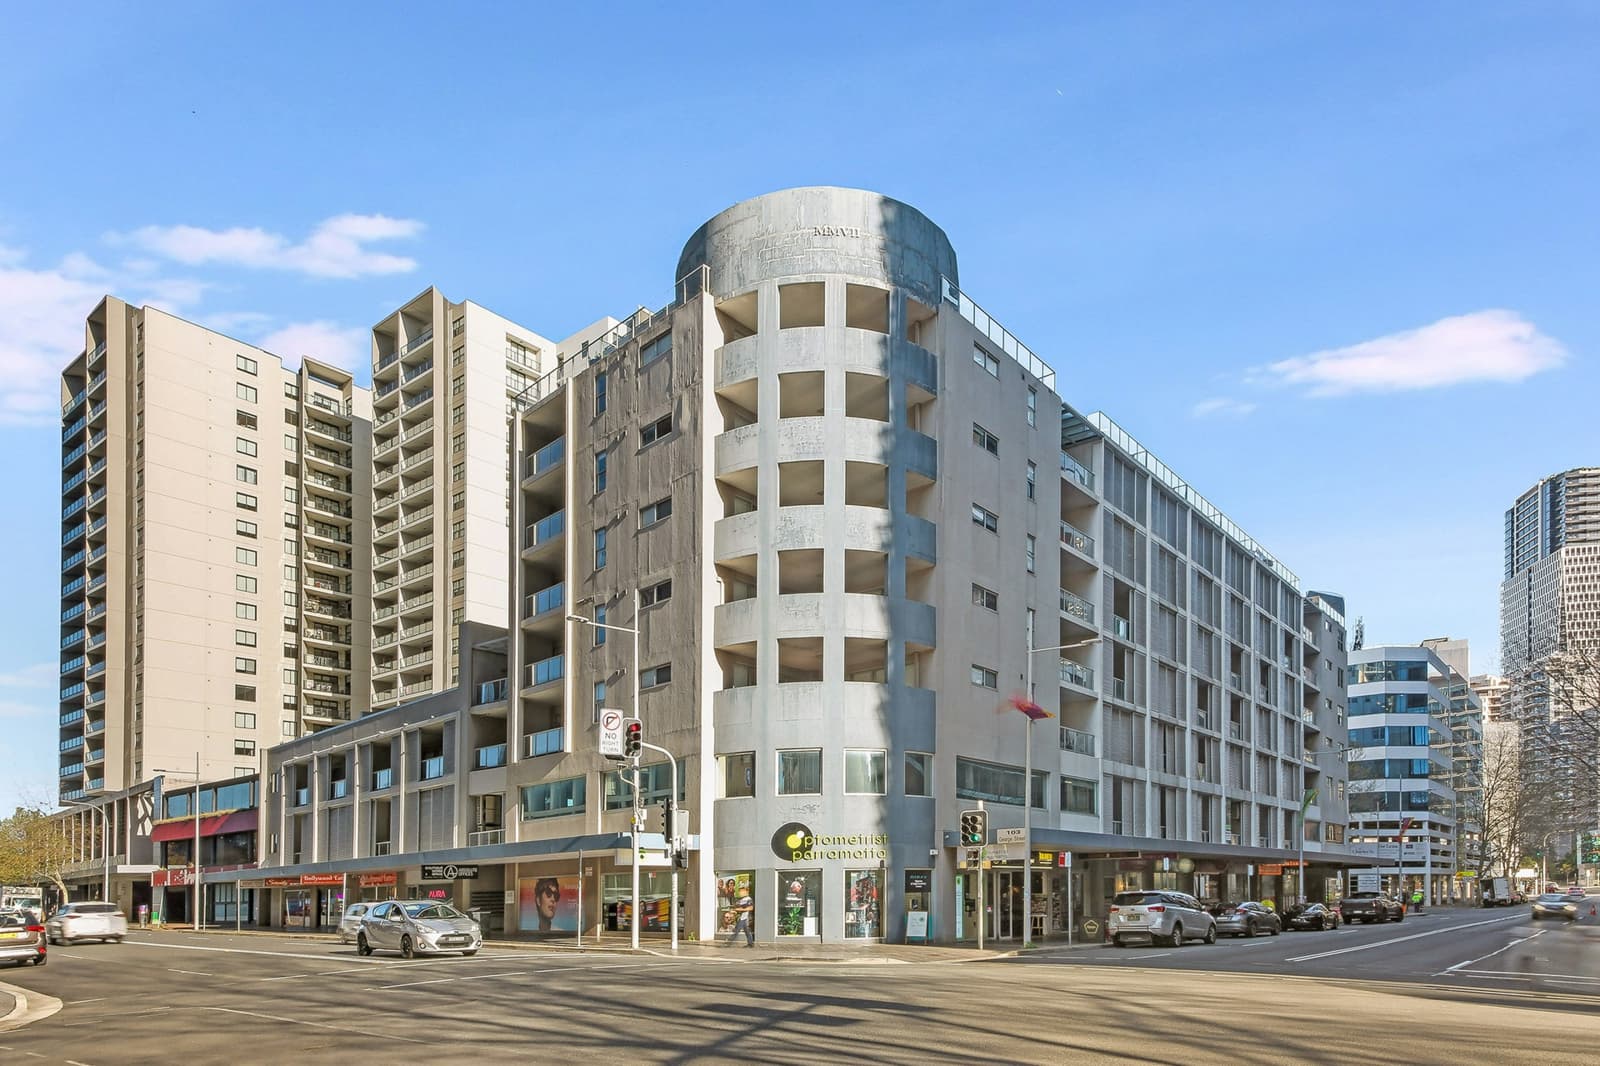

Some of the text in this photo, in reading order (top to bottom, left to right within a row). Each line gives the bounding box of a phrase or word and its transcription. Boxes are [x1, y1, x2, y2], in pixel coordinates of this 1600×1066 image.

[813, 226, 861, 238] MMVII
[604, 732, 617, 740] NO
[428, 889, 447, 898] AURA
